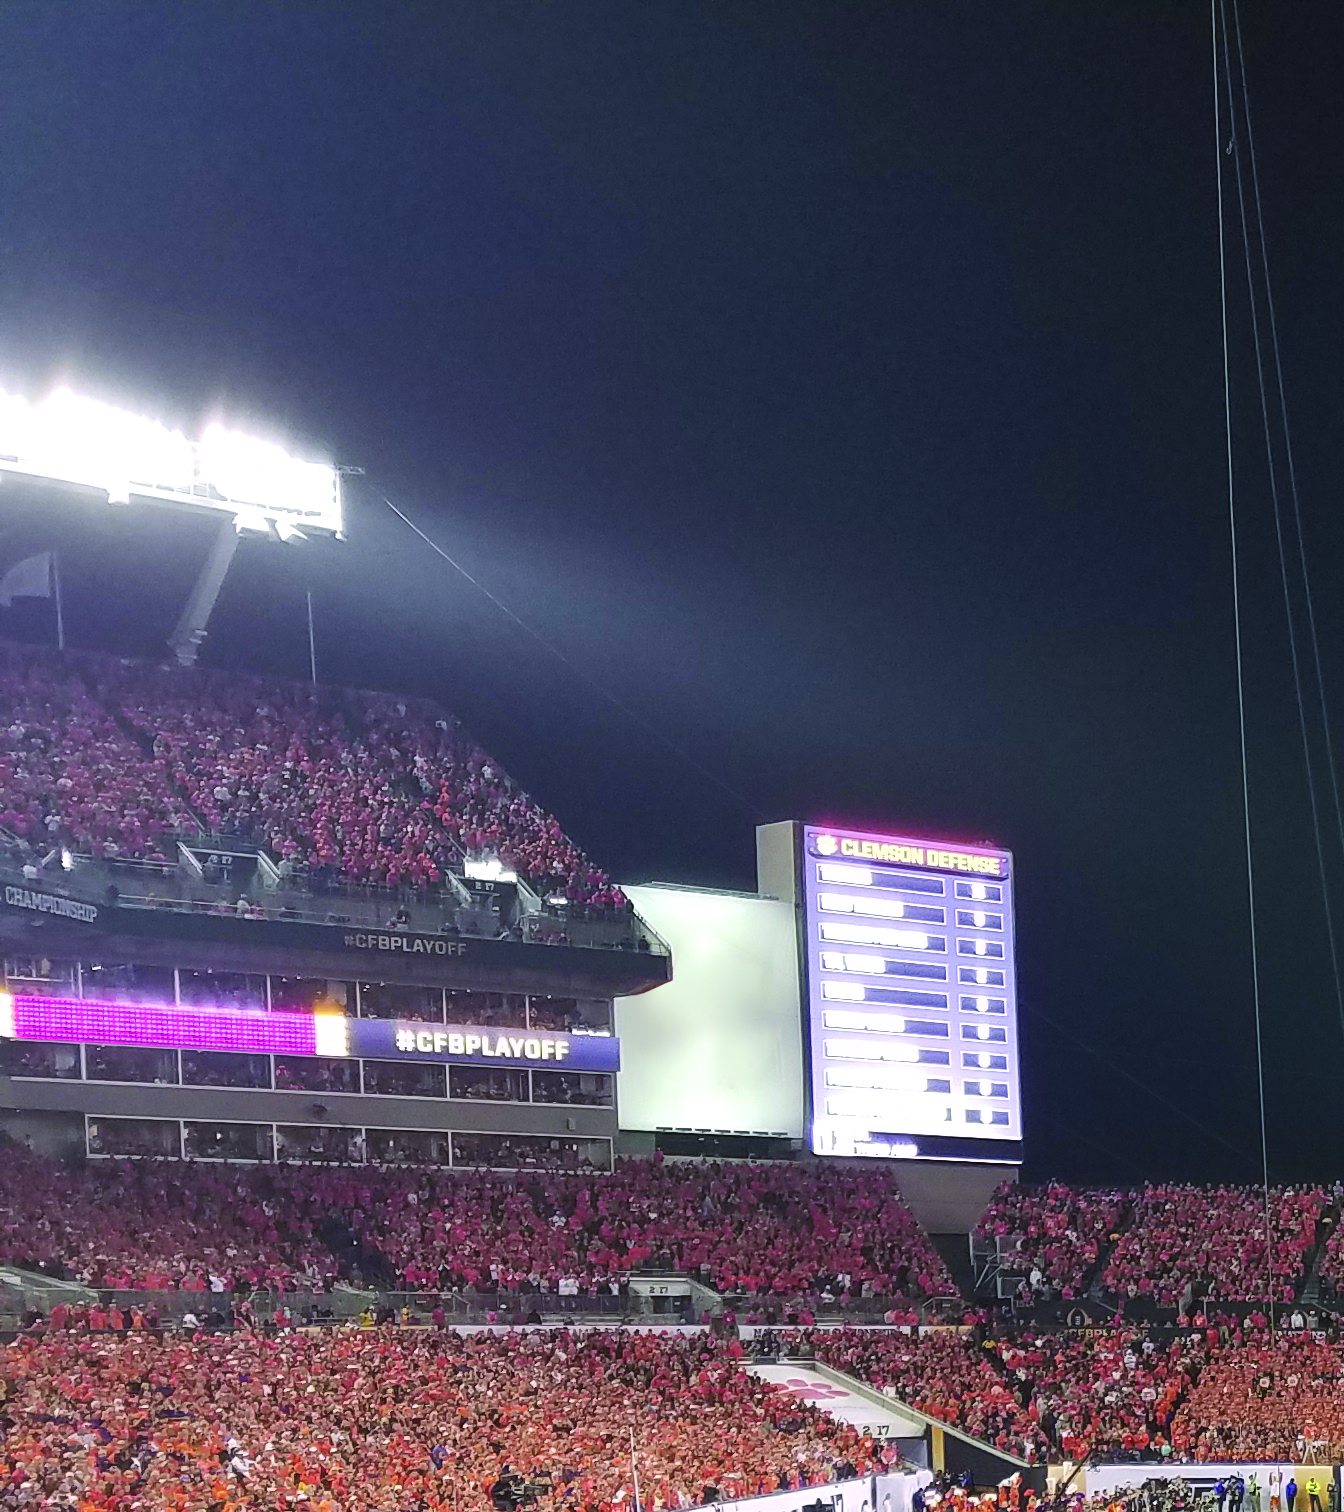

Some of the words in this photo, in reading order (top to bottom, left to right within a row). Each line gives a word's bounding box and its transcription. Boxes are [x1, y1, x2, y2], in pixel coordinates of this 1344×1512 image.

[841, 839, 925, 865] CLEMSON
[926, 852, 1001, 876] DEFENSE
[5, 885, 98, 923] CHAMPIONSHIP
[344, 934, 467, 956] #CFBPLAYOFF
[396, 1029, 570, 1061] #CFBPLAYOFF
